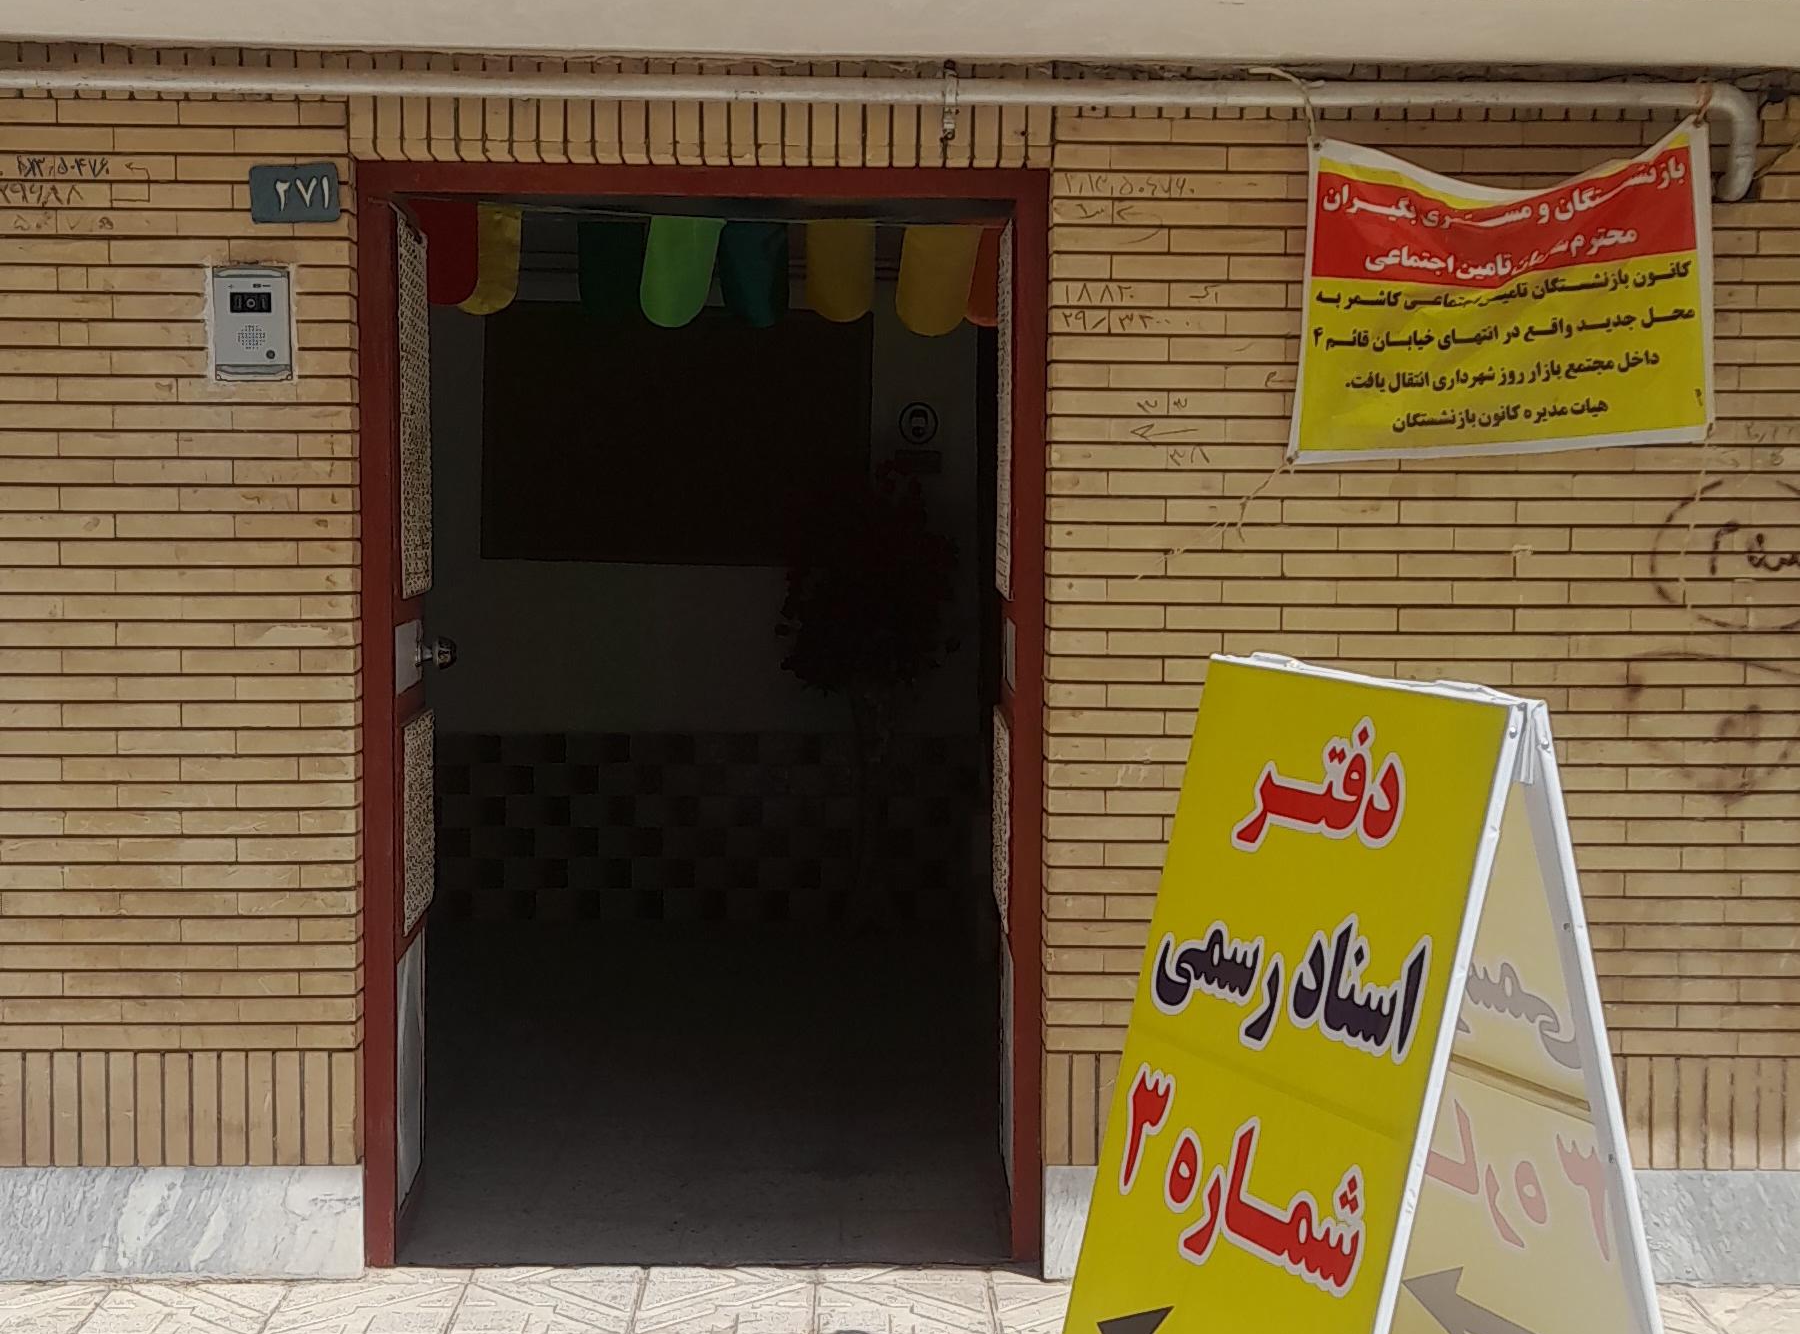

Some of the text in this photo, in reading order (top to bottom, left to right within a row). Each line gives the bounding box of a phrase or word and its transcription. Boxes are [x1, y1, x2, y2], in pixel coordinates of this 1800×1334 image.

[274, 175, 331, 212] ۲۷۱
[1322, 184, 1417, 225] بگیران
[1420, 205, 1532, 229] مستری
[1537, 202, 1550, 224] و
[1569, 227, 1638, 258] محترم
[1365, 245, 1454, 276] اجتماعی
[1456, 253, 1513, 279] تامین
[1532, 268, 1630, 299] بازنشستگان
[1633, 261, 1692, 288] کانون
[1316, 291, 1341, 308] به
[1344, 289, 1402, 310] کاشمر
[1524, 317, 1573, 342] واقع
[1576, 314, 1637, 333] جدید
[1641, 306, 1696, 329] محل
[1326, 329, 1369, 351] قائم
[1372, 328, 1435, 353] خیابان
[1437, 325, 1499, 350] انتهای
[1503, 326, 1520, 344] در
[1528, 360, 1561, 383] بازار
[1565, 358, 1614, 379] مجتمع
[1618, 350, 1660, 372] داخل
[1388, 371, 1429, 393] انتقال
[1432, 366, 1496, 391] شهرداری
[1498, 367, 1524, 386] روز
[1392, 398, 1608, 433] هیات مدیره کانون بازنشستگان
[1234, 720, 1403, 848] دفتر
[1152, 919, 1430, 1058] اسناد رسمی
[1121, 1067, 1364, 1291] شماره ۳
